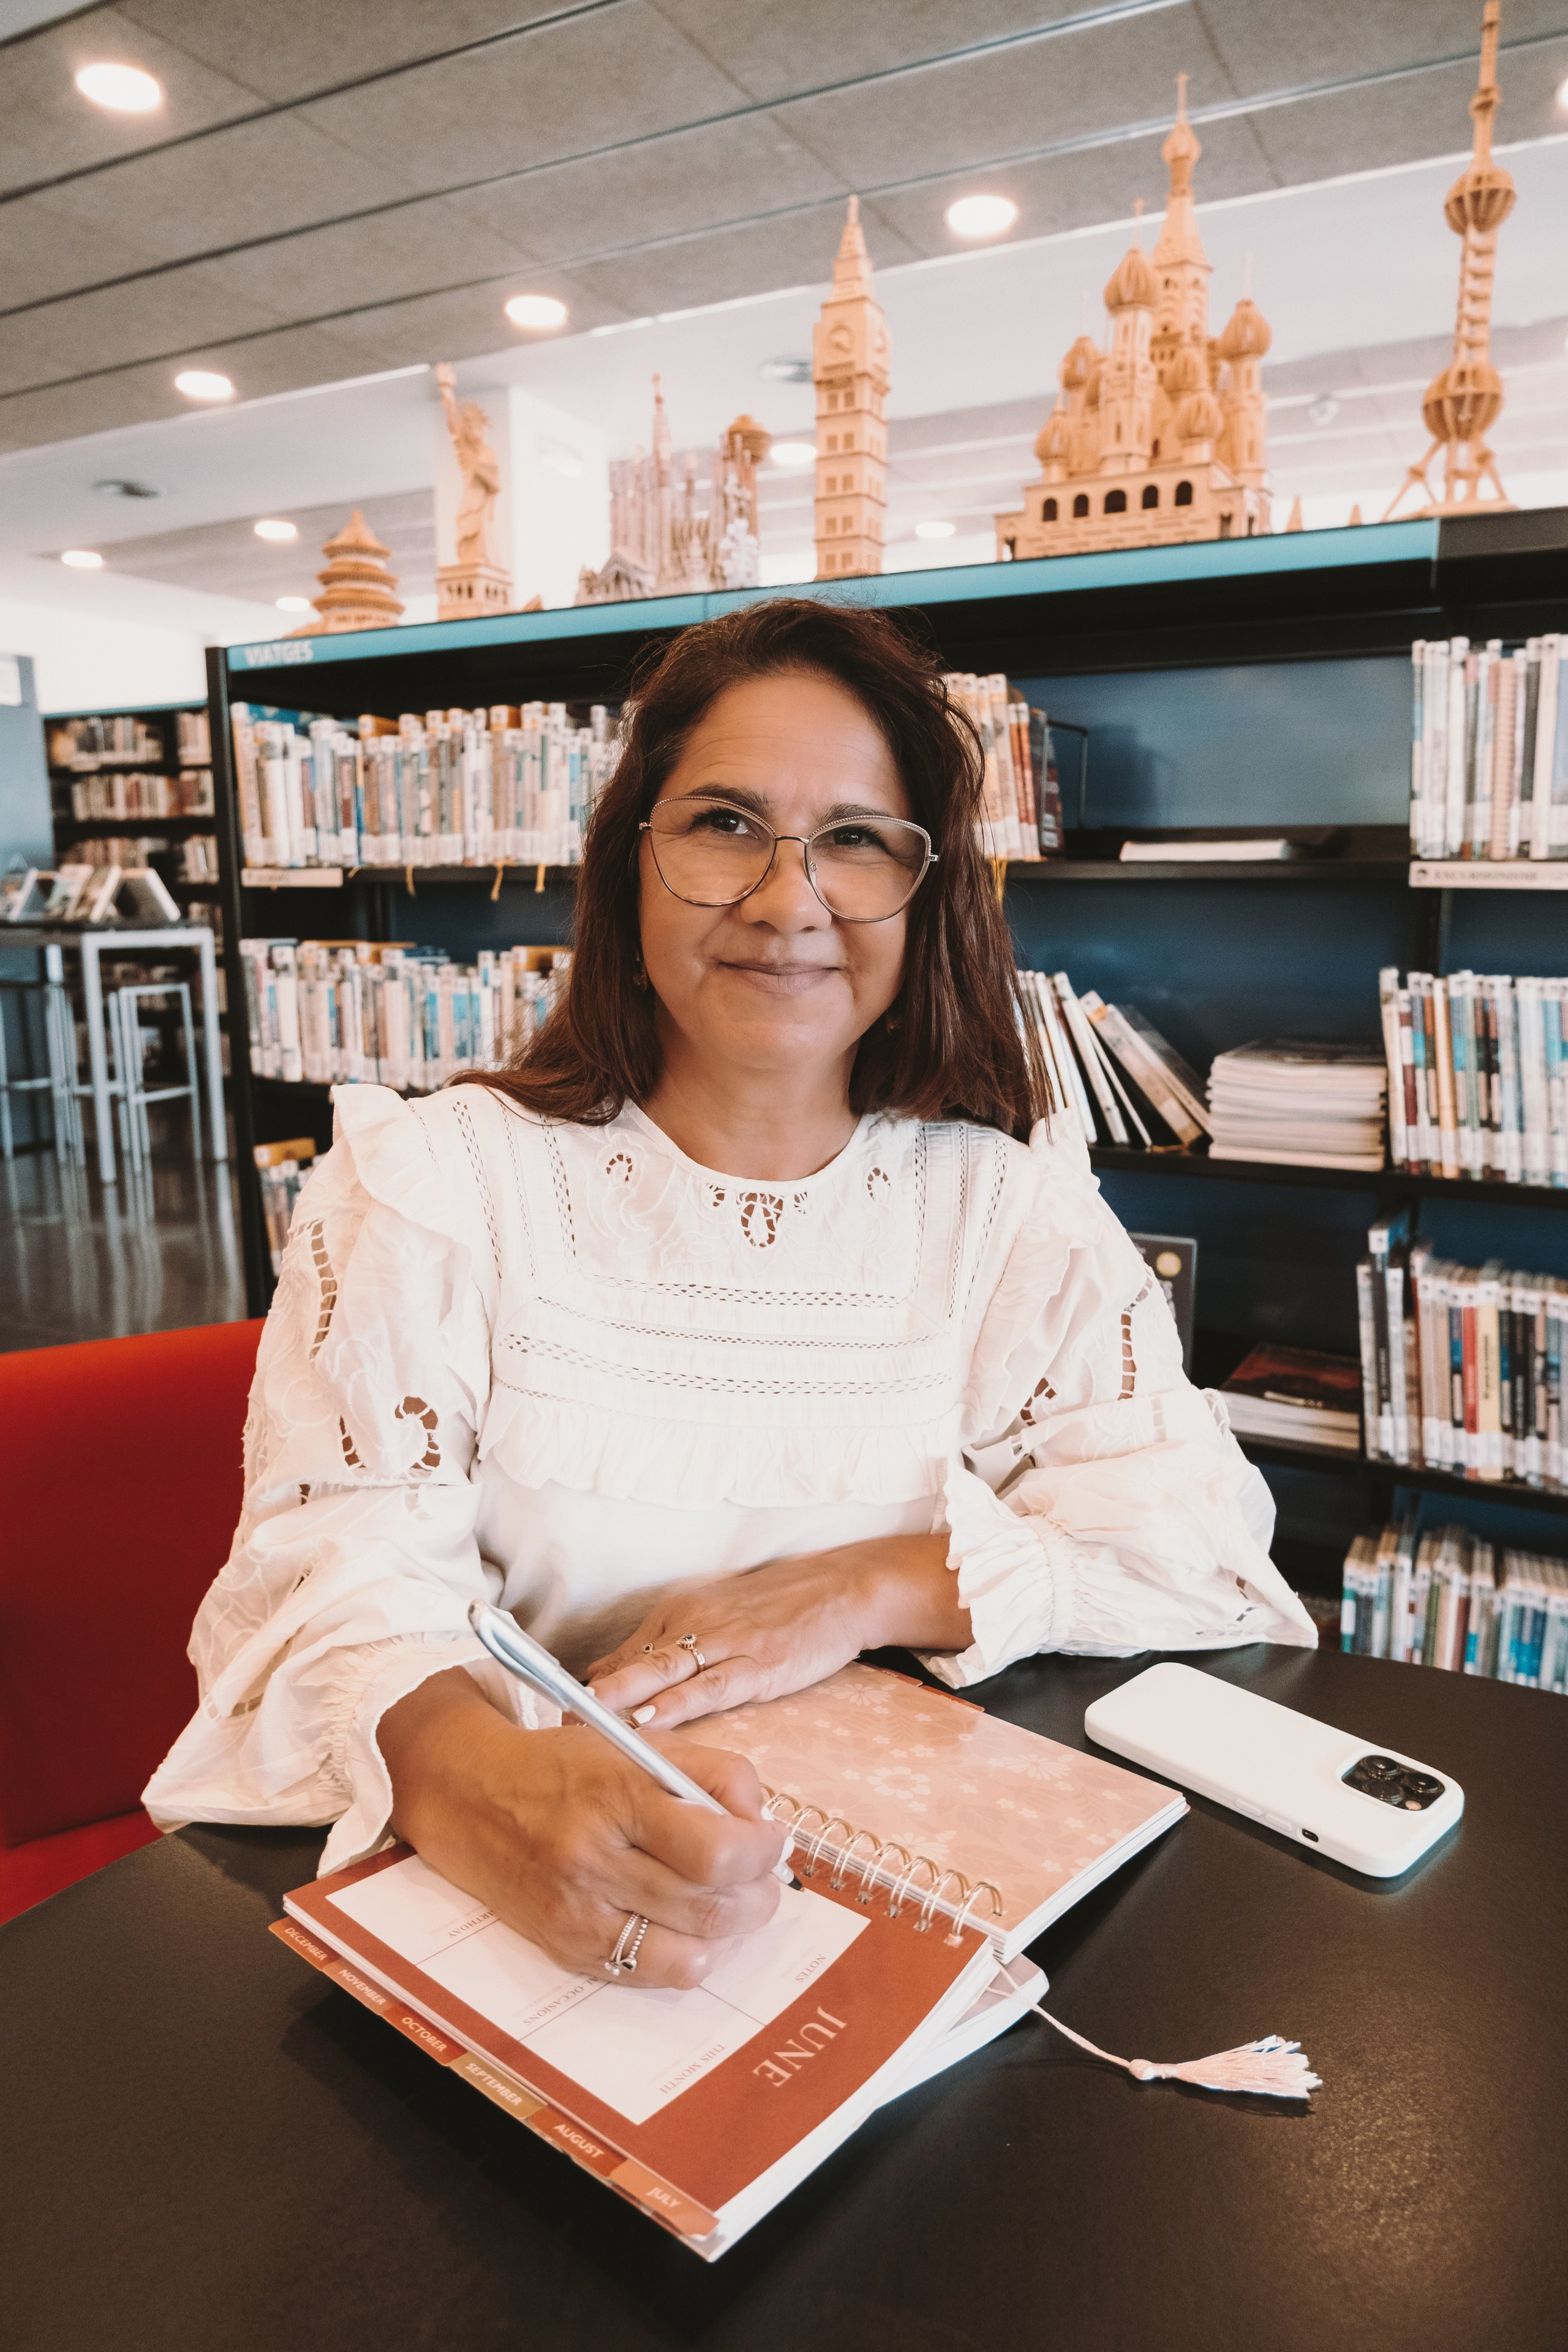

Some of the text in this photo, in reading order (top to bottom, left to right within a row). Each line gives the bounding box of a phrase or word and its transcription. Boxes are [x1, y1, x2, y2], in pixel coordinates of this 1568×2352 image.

[448, 1910, 495, 1938] IRTHDAY
[284, 1928, 327, 1961] DECEMBER
[795, 1954, 826, 1983] NOTES
[339, 1969, 386, 2005] NOVEMBER
[523, 1986, 584, 2025] OCCASIONS
[402, 2016, 447, 2052] OCTOBER
[752, 2005, 847, 2087] JUNE
[701, 2044, 726, 2062] THIS
[465, 2062, 523, 2106] SEPTEMBER
[659, 2062, 703, 2094] MONTH
[554, 2124, 605, 2158] AUGUST
[646, 2187, 681, 2208] JULY
